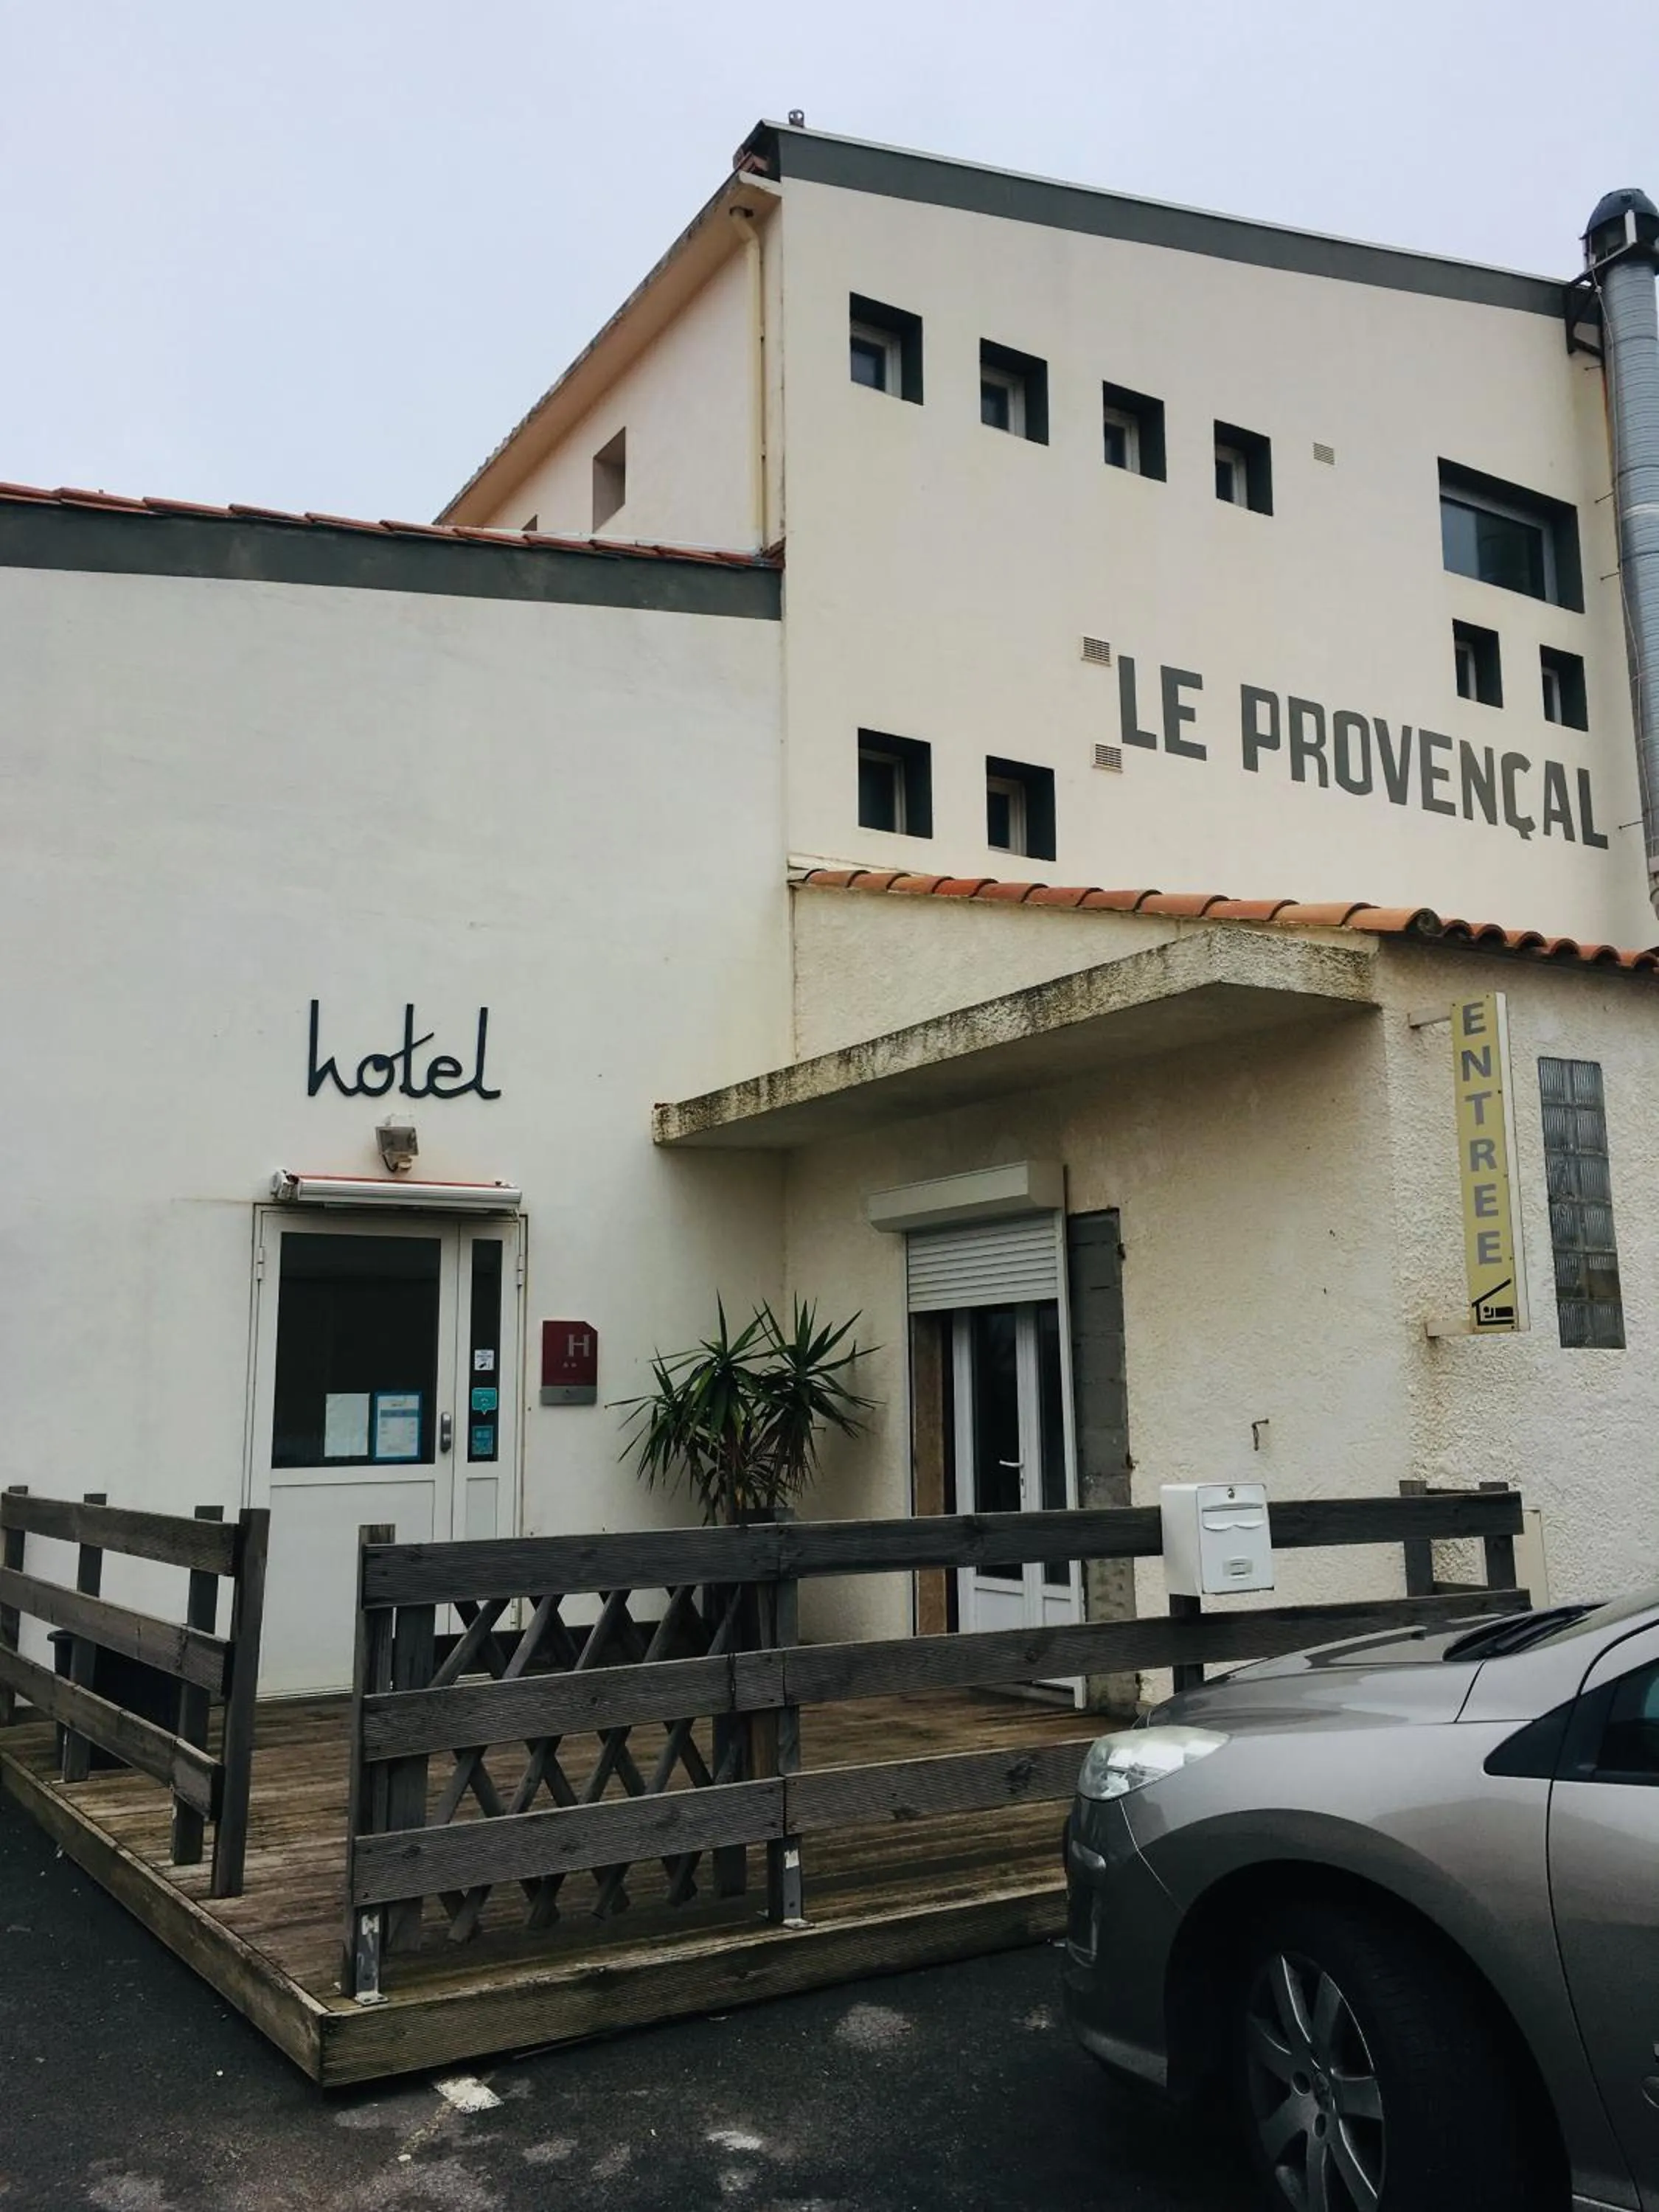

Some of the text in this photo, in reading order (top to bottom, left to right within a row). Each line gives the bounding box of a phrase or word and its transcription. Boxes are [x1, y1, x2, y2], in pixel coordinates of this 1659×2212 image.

[1118, 655, 1609, 850] LE PROVENÇAL
[307, 999, 501, 1099] hotel
[1461, 1002, 1503, 1265] ENTREE
[568, 1334, 590, 1357] H
